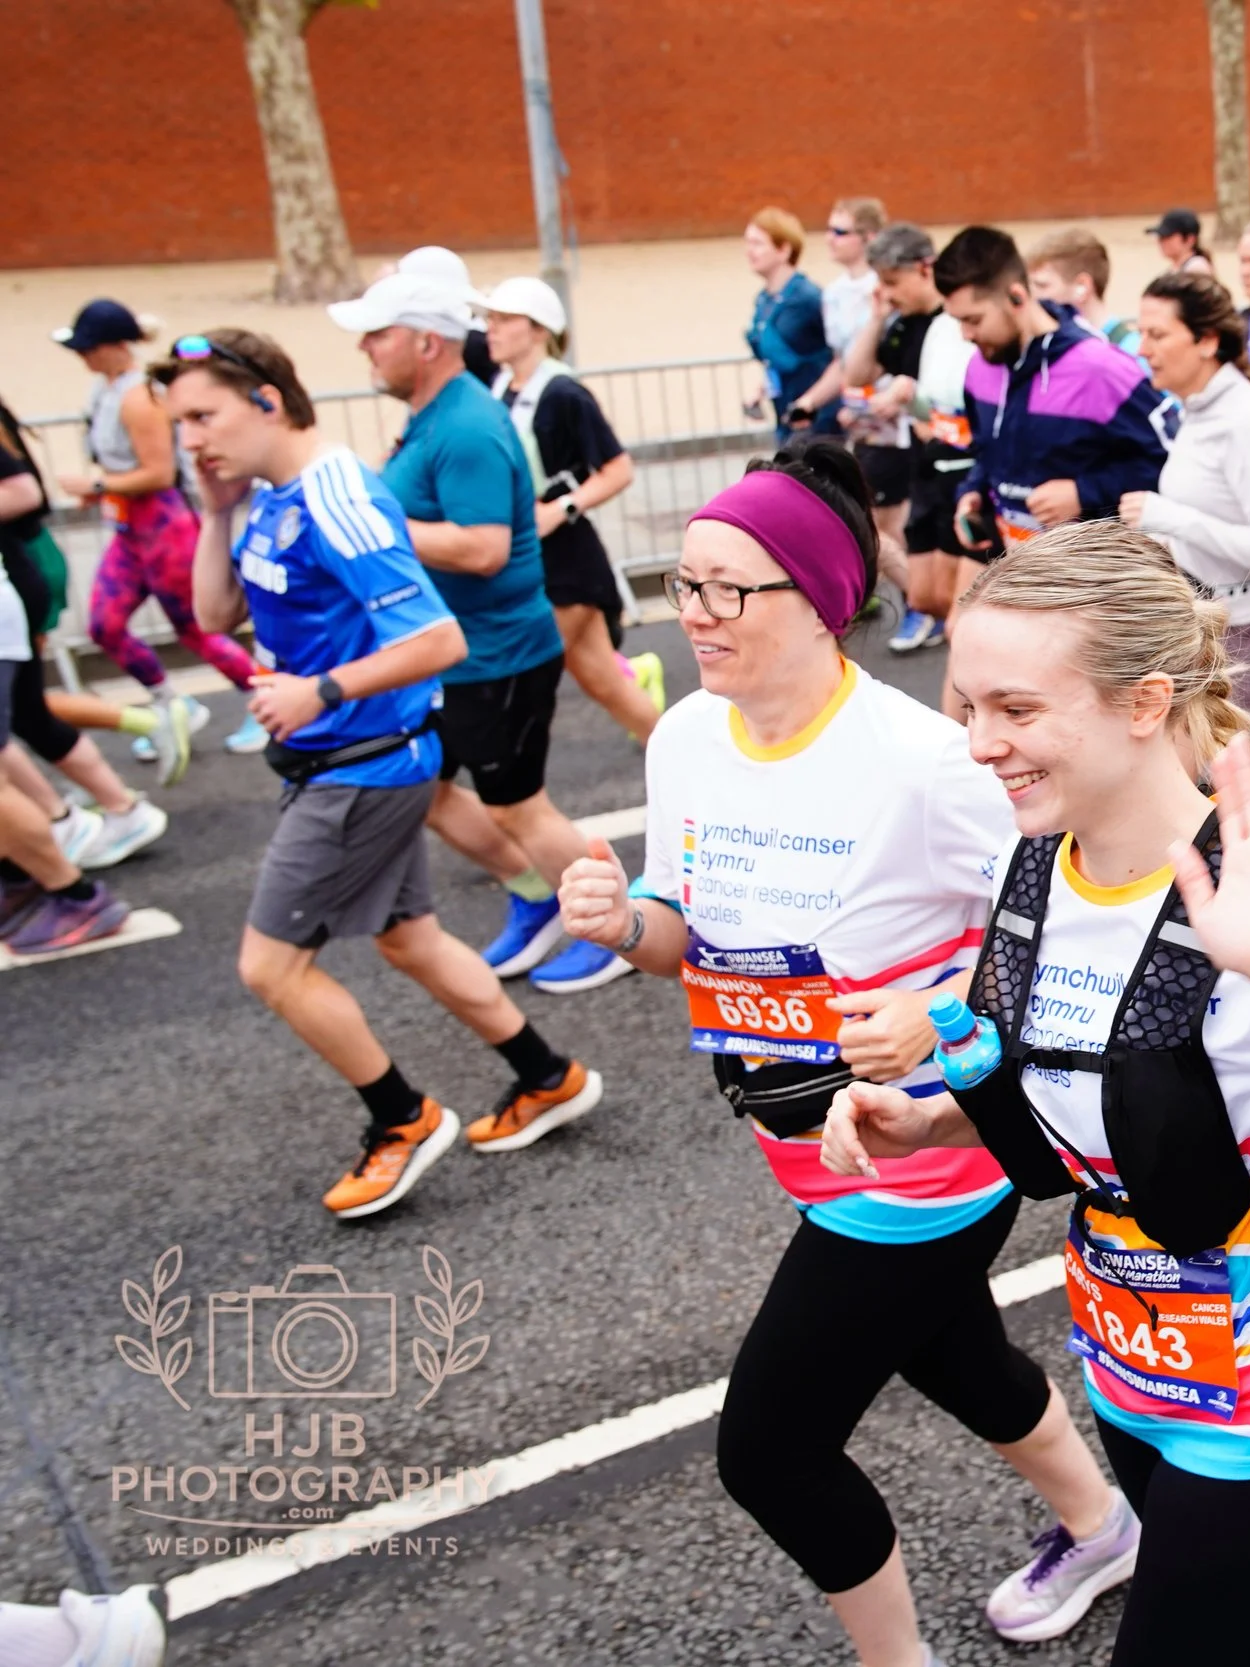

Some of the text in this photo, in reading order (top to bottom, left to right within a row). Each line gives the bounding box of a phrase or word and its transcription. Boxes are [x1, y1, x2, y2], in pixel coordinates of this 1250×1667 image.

[701, 823, 856, 855] ymchwil canser
[700, 849, 756, 873] cymru
[697, 875, 842, 911] cancer research
[696, 903, 742, 926] wales
[726, 950, 787, 964] SWANSEA
[682, 967, 766, 995] RHIANNON
[715, 993, 813, 1034] 6936
[1031, 993, 1096, 1025] cymru
[1101, 1251, 1179, 1271] SWANSEA
[1066, 1252, 1103, 1302] CARYS
[1125, 1269, 1181, 1283] Marathon
[1191, 1303, 1227, 1313] CANCER
[1200, 1315, 1228, 1326] WALES
[1086, 1300, 1193, 1371] 1843
